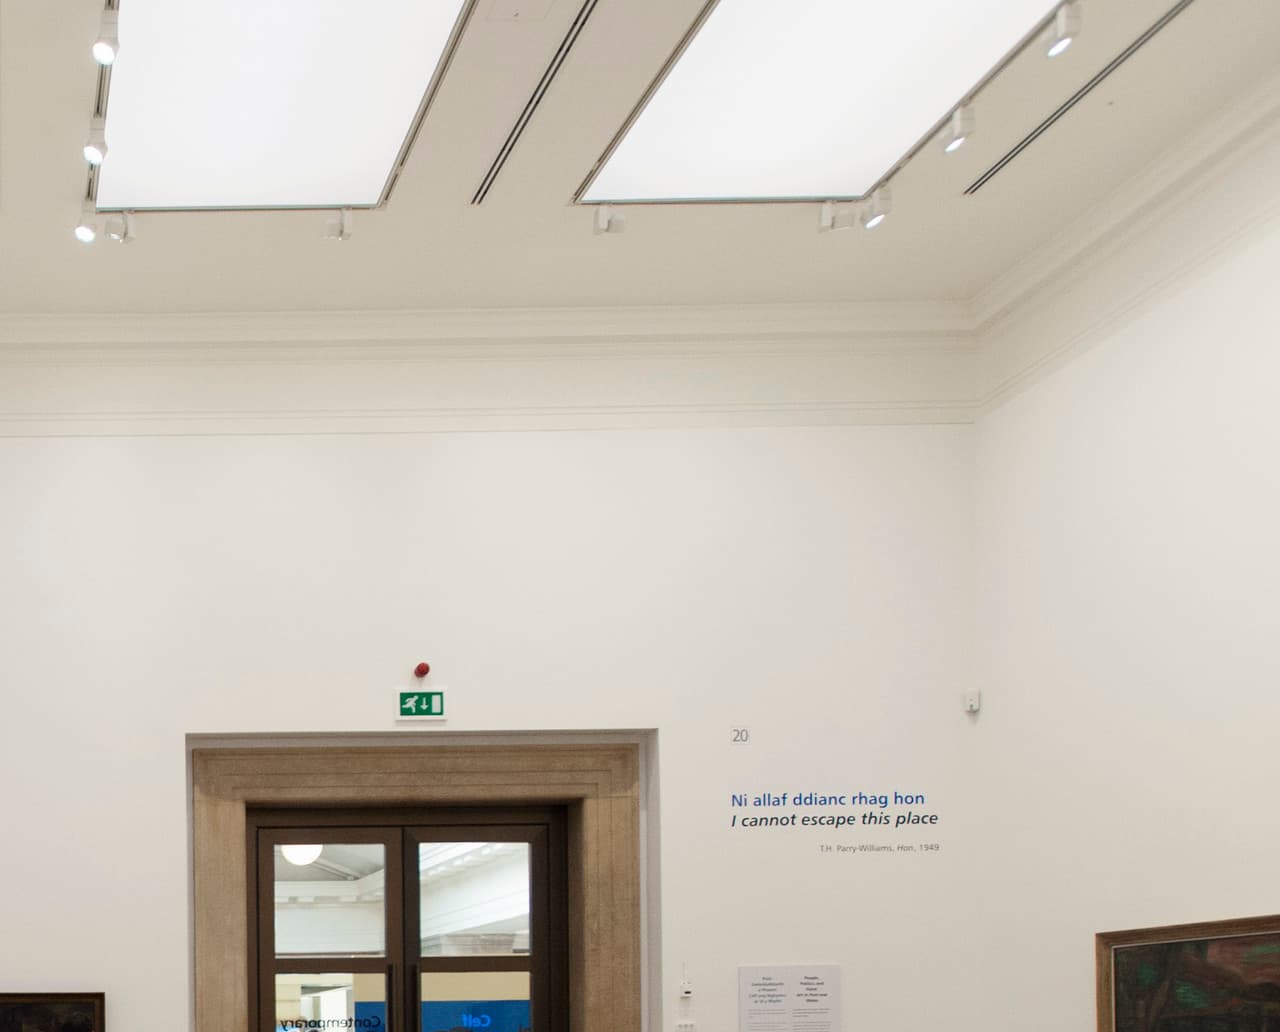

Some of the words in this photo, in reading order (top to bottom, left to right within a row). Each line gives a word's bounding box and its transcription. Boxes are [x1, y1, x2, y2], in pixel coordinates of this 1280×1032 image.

[732, 729, 749, 743] 20
[732, 793, 747, 807] Ni
[753, 792, 787, 806] allaf
[793, 792, 846, 806] ddianc
[852, 791, 888, 808] rhag
[894, 791, 924, 805] hon
[731, 815, 736, 827] I
[741, 814, 796, 827] cannot
[801, 815, 856, 829] escape
[862, 812, 890, 825] this
[896, 811, 938, 828] place
[919, 843, 940, 852] 1949
